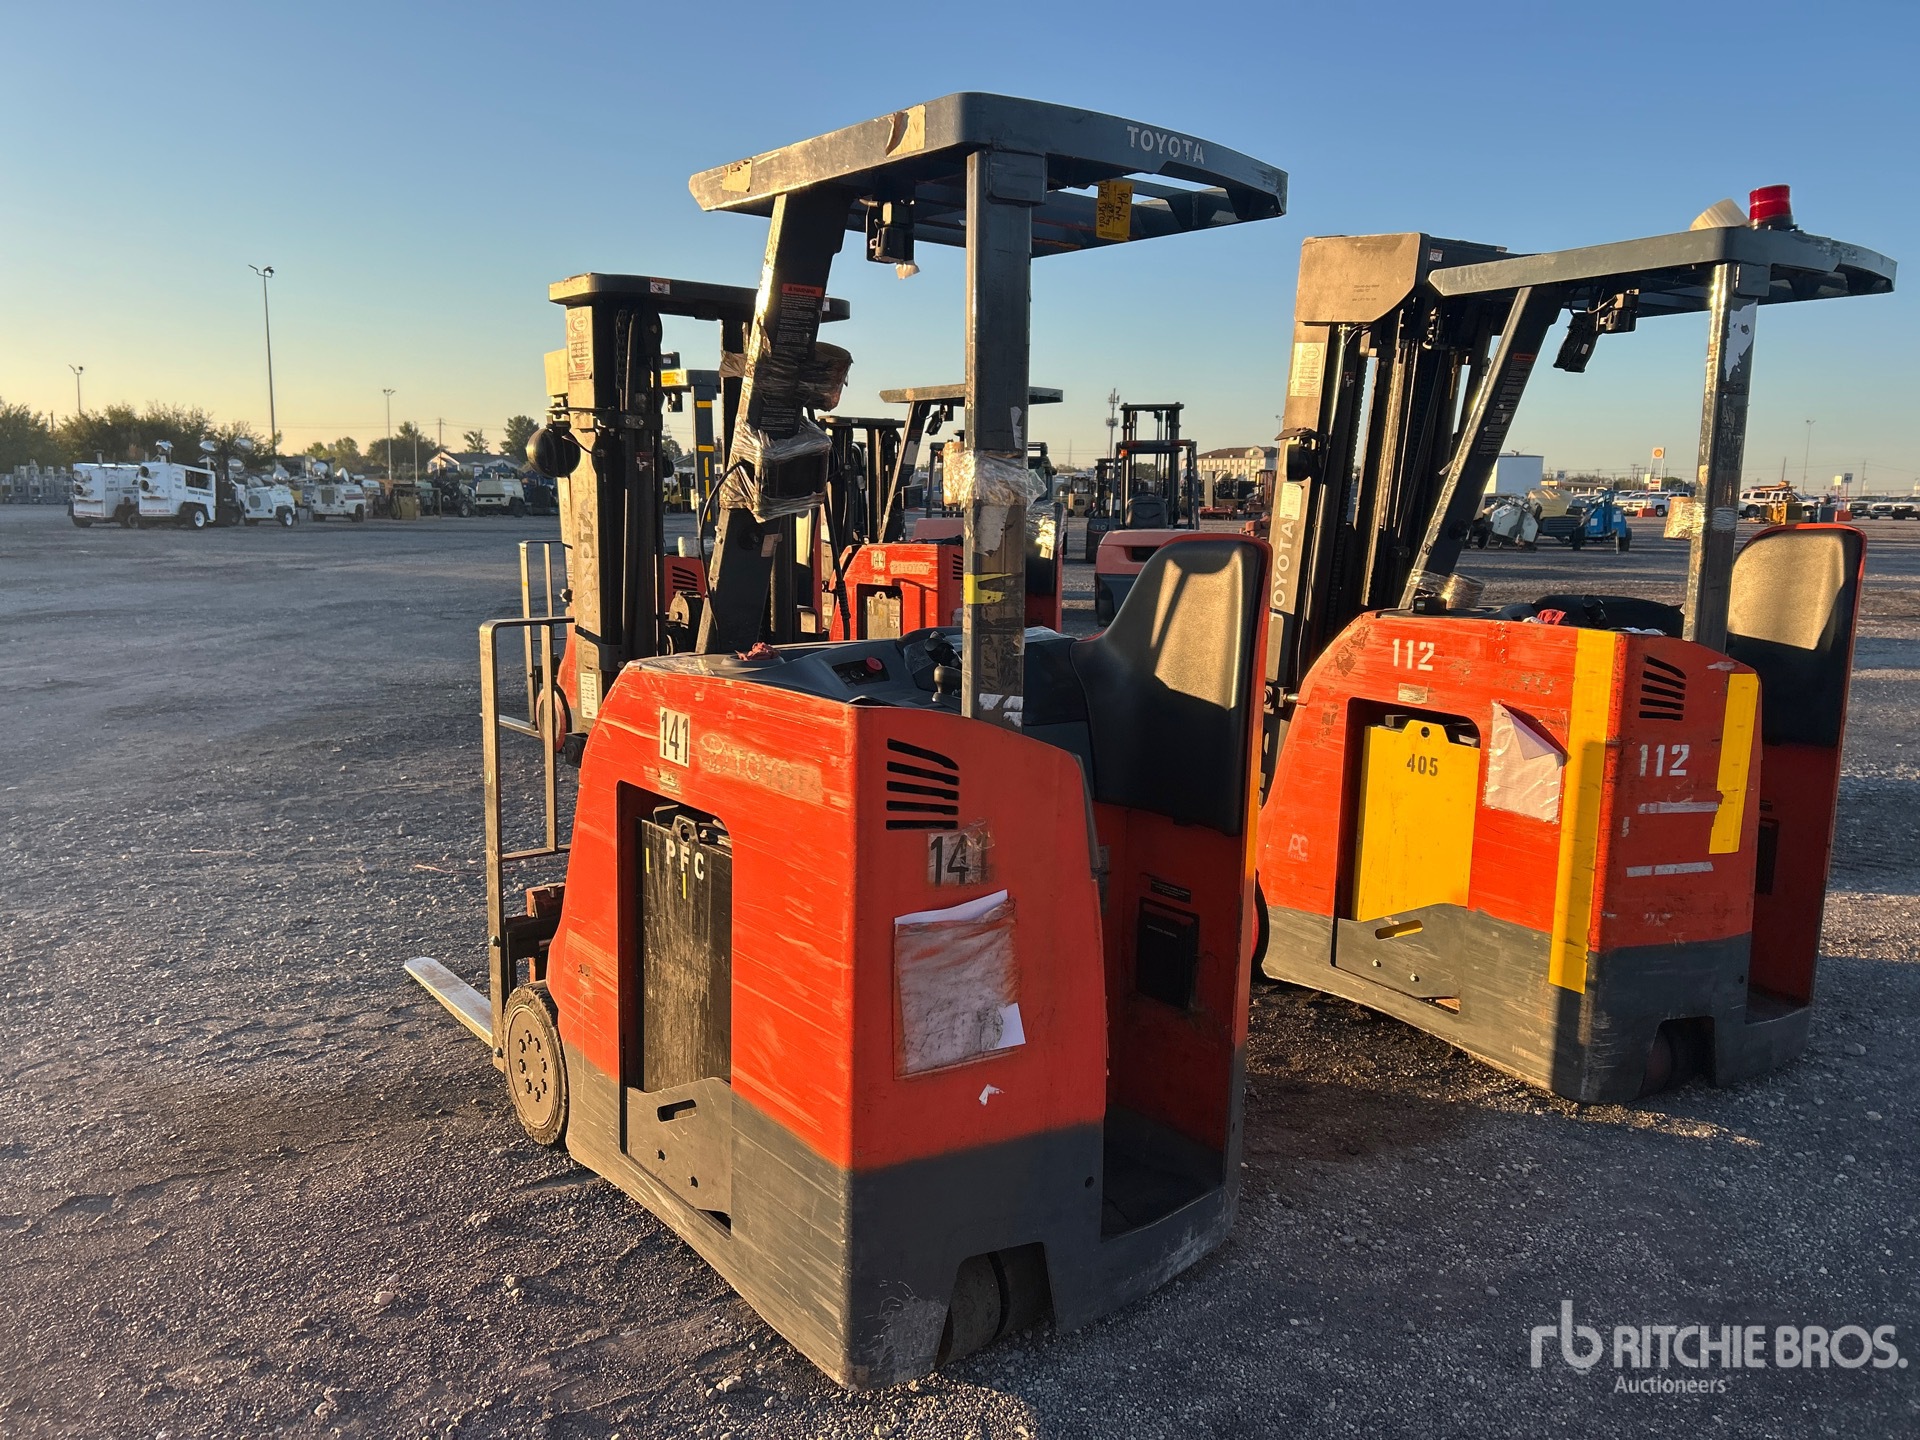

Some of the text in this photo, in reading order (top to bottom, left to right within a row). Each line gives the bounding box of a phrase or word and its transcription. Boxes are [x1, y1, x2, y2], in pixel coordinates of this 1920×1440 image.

[1126, 125, 1205, 165] TOYOTA
[1392, 638, 1435, 671] 112
[661, 711, 688, 764] 141
[1406, 753, 1439, 777] 405
[1639, 744, 1690, 777] 112
